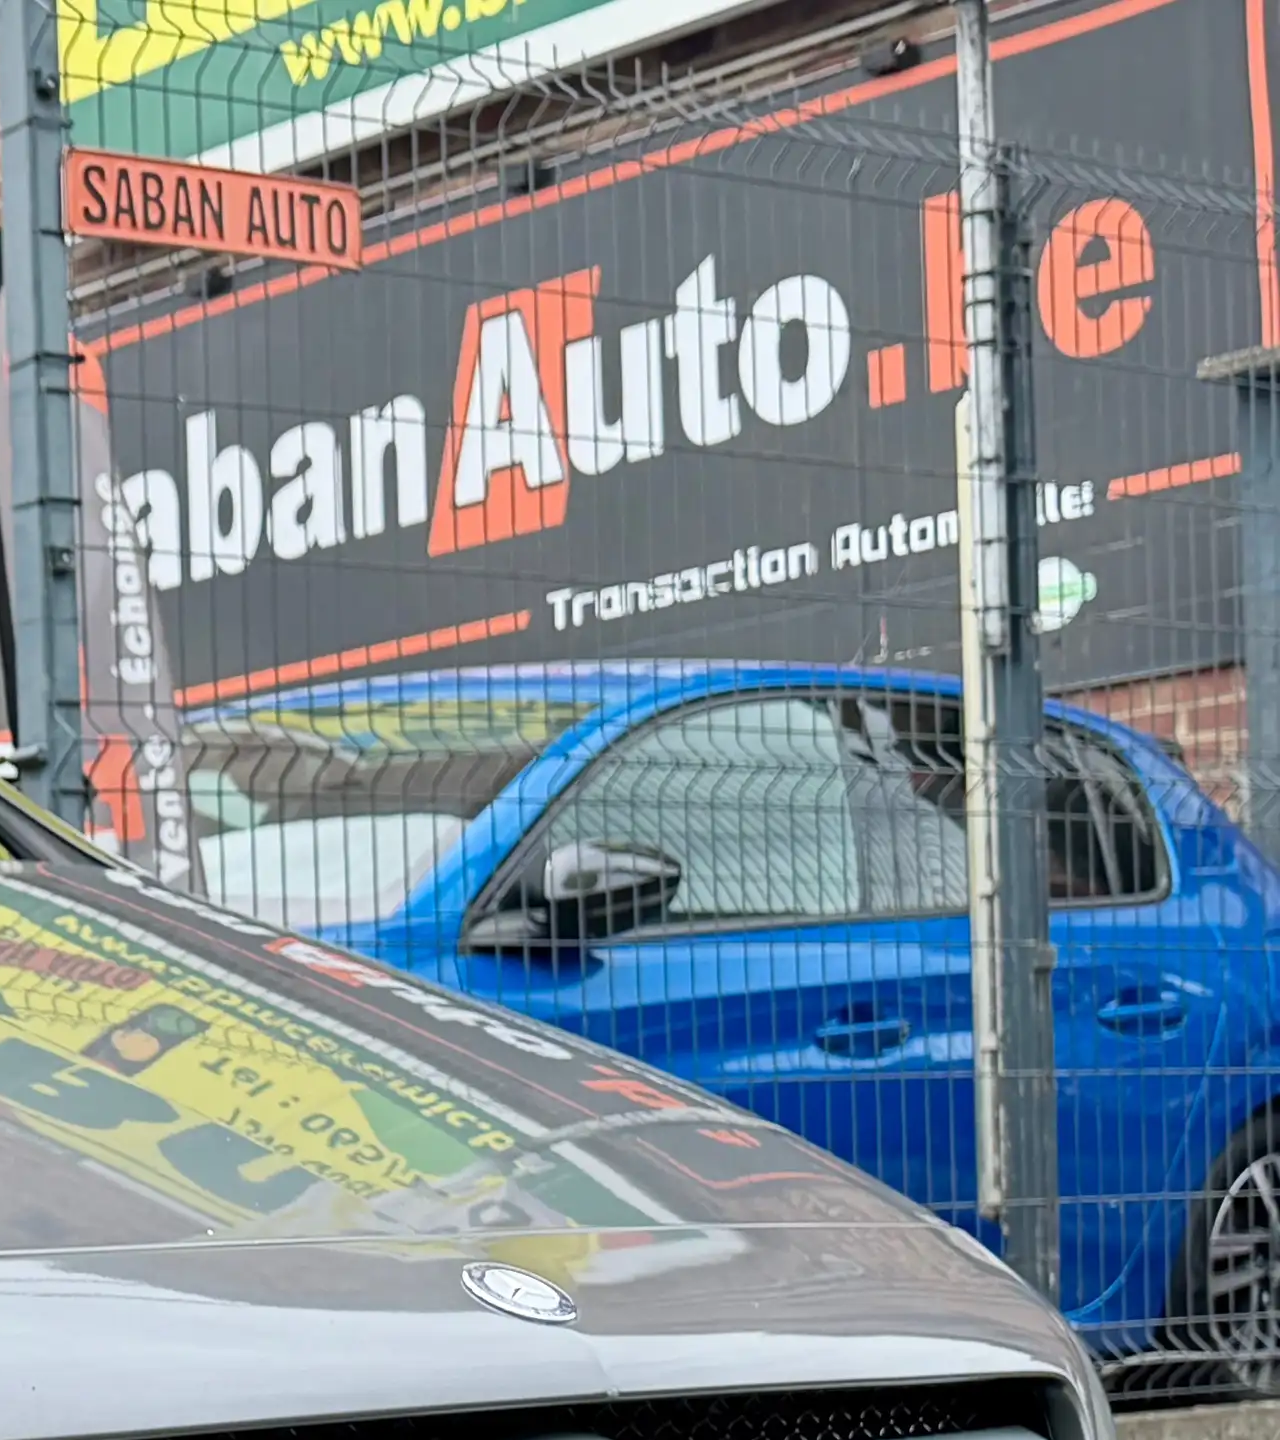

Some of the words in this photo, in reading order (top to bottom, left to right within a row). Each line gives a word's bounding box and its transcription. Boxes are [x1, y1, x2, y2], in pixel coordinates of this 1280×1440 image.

[82, 164, 225, 242] SABAN
[246, 186, 349, 256] AUTO
[122, 188, 1155, 592] abanAuto.e
[546, 543, 818, 632] Transaction
